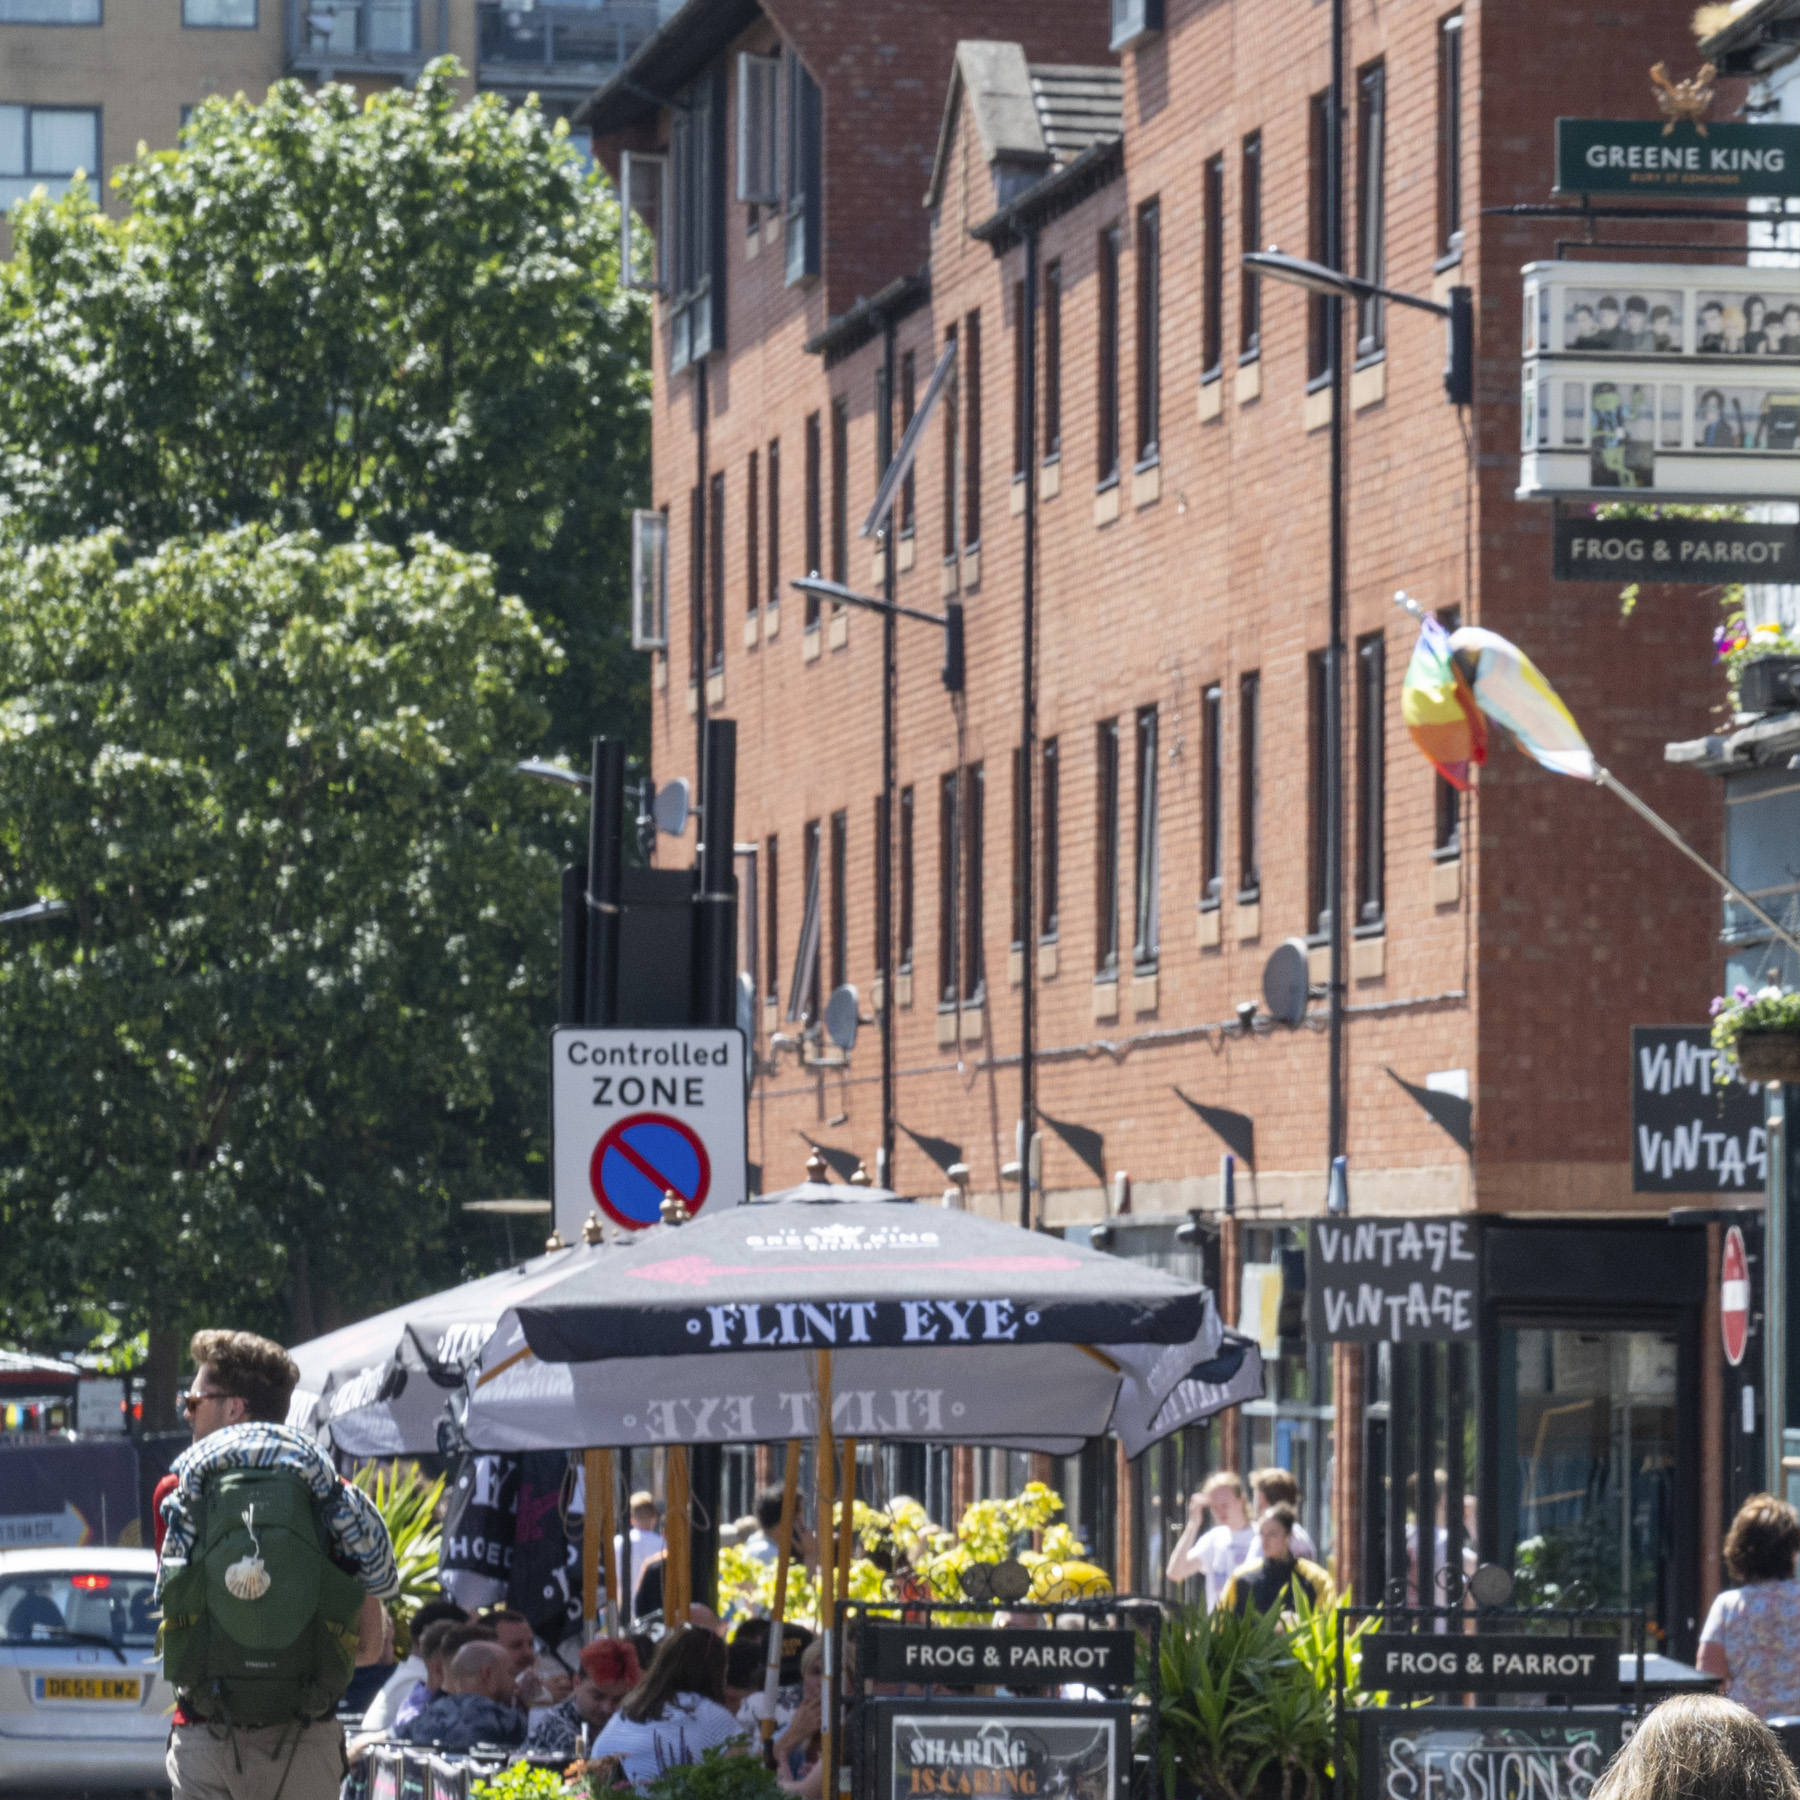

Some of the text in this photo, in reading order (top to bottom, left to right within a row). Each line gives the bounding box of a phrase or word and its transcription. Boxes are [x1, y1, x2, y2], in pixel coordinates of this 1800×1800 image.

[1585, 145, 1785, 172] GREENE KING
[1571, 538, 1785, 564] FROG & PARROT
[568, 1041, 729, 1067] Controlled
[592, 1077, 704, 1107] ZONE
[1317, 1221, 1476, 1273] VINTAGE
[705, 1298, 1020, 1347] FLINT EYE
[1323, 1281, 1473, 1343] VINTAGE
[906, 1645, 1110, 1668] FROG & PARROT
[1386, 1652, 1595, 1676] FROG & PARROT
[910, 1738, 1027, 1768] SHARING
[910, 1768, 1036, 1794] IS CARING
